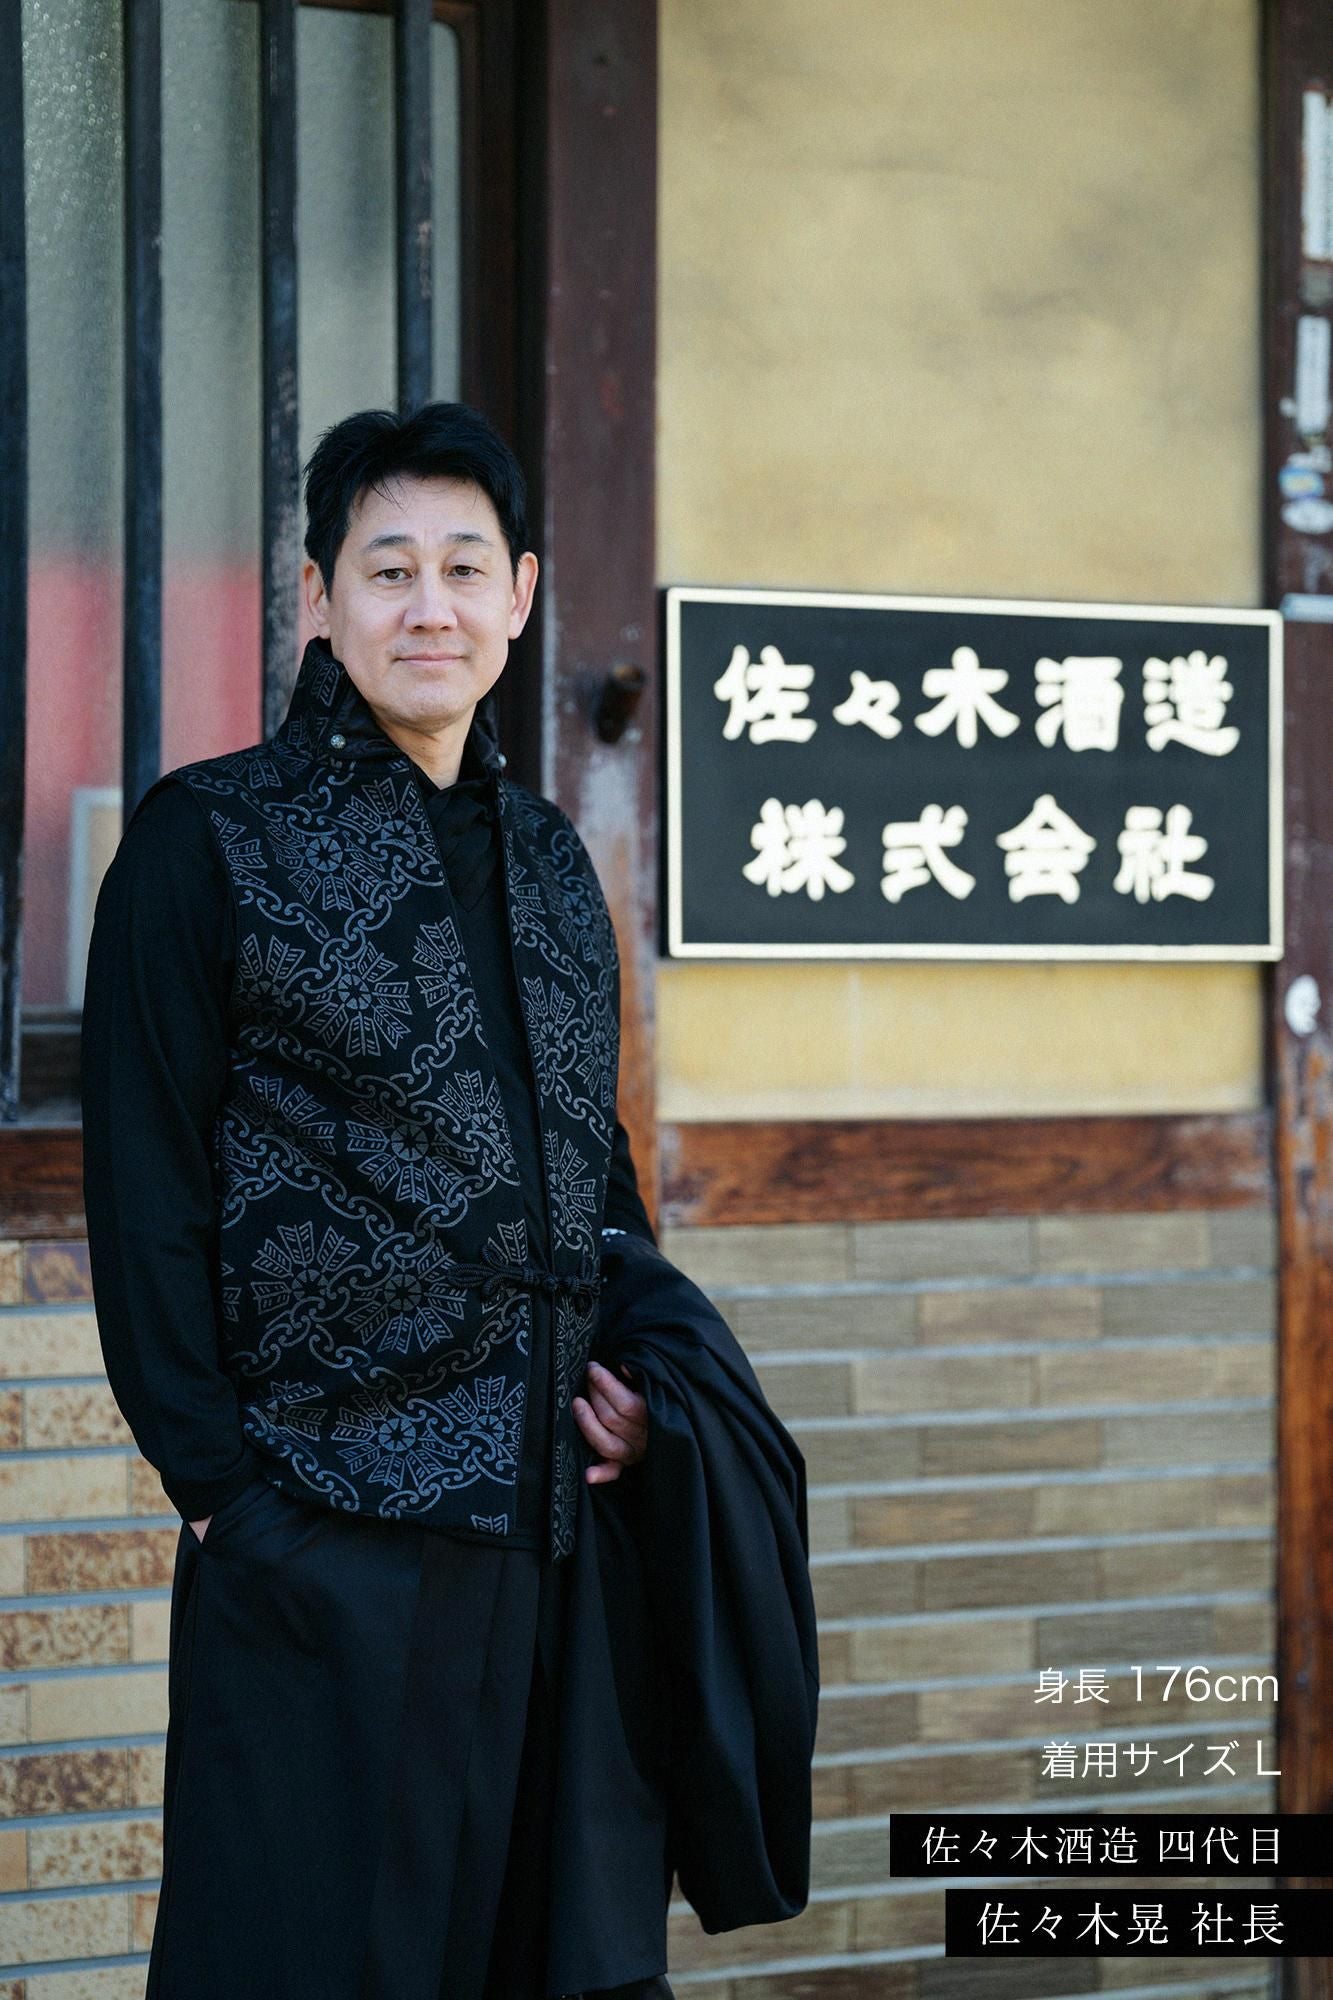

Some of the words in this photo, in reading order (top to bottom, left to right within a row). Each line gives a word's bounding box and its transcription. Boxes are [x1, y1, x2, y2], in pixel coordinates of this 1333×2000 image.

[714, 644, 1240, 756] 佐々木酒造
[742, 794, 1215, 904] 株式会社
